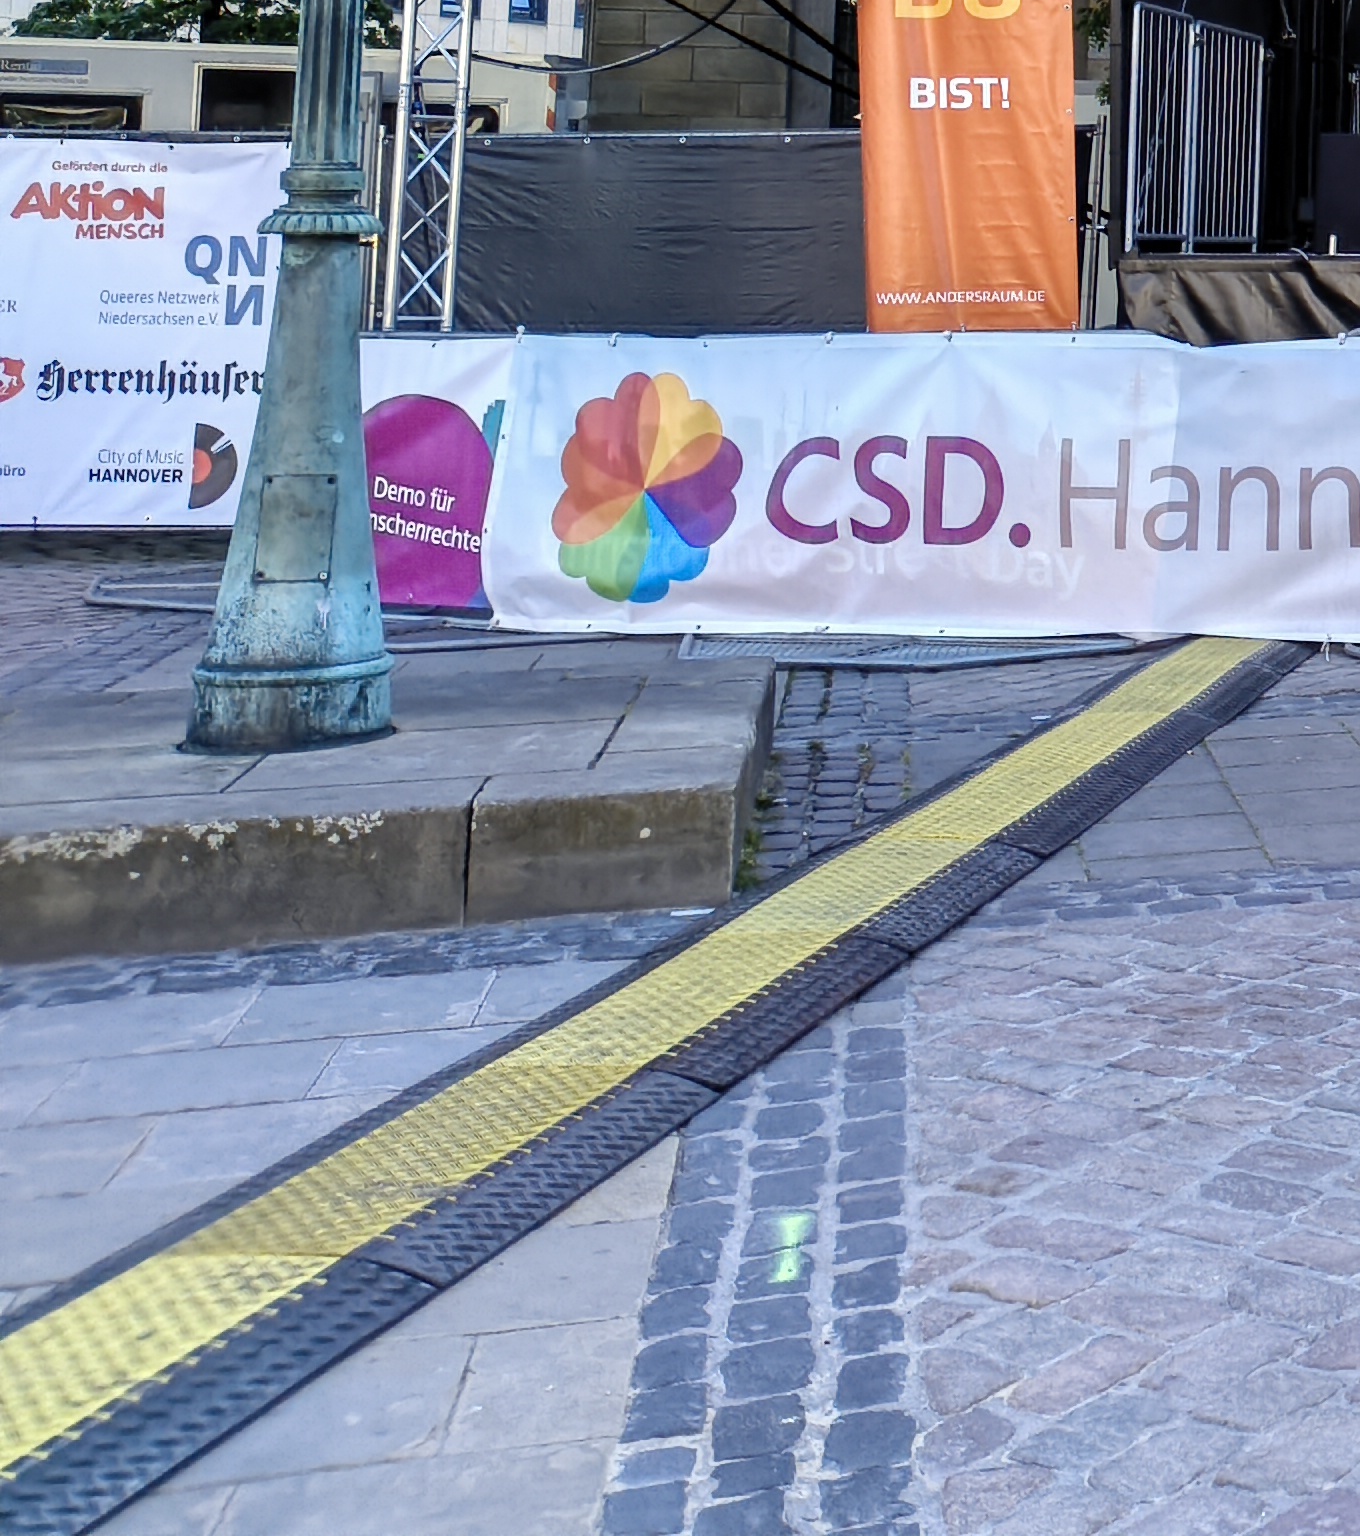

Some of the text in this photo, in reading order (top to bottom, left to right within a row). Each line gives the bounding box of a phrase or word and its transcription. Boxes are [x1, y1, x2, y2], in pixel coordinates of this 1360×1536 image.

[909, 77, 1010, 110] BIST!
[111, 162, 146, 173] durch
[75, 223, 164, 240] MENSCH
[99, 289, 220, 305] Queeres Netzwerk
[876, 290, 1046, 305] WWW.ANDERSRAUM.DE
[98, 311, 194, 326] Niedersachsen
[98, 448, 184, 466] City of Music
[89, 468, 183, 483] HANNOVER
[373, 475, 456, 513] Demo für
[766, 435, 1033, 547] CSD.
